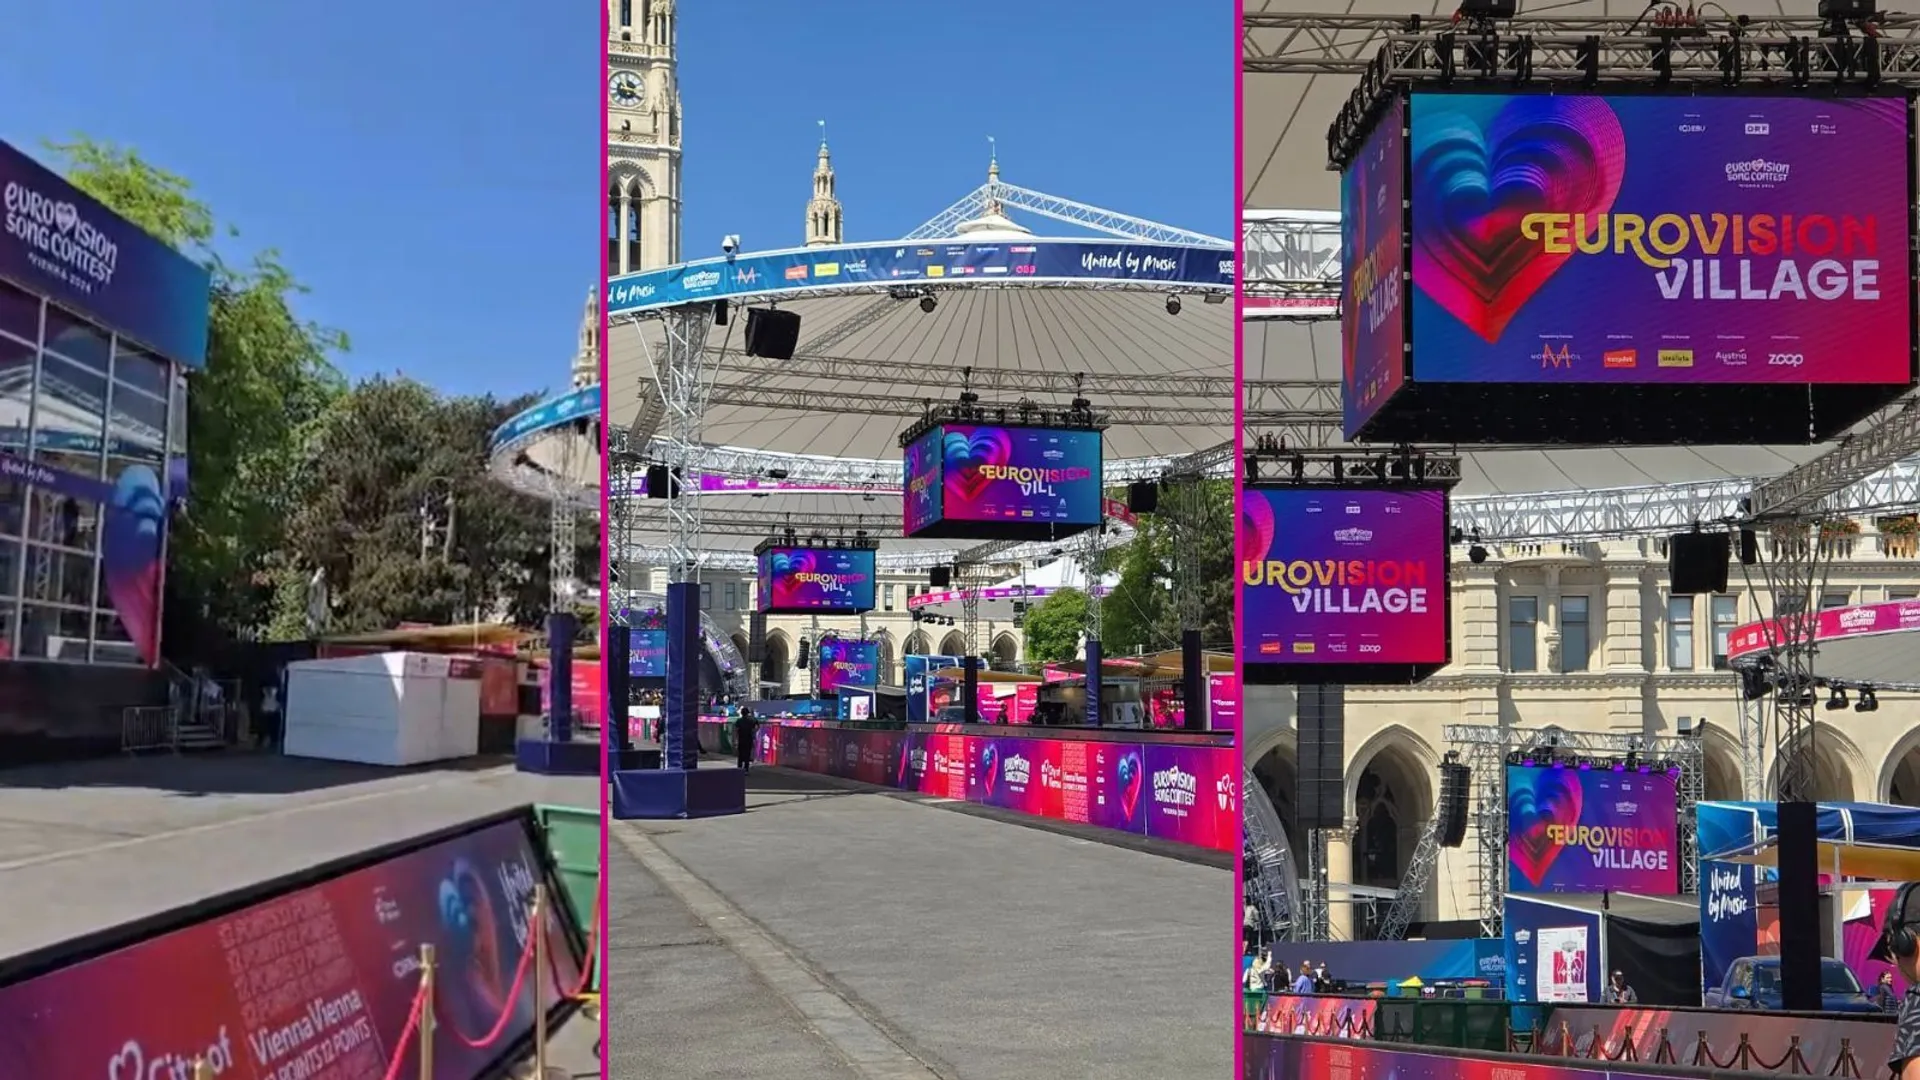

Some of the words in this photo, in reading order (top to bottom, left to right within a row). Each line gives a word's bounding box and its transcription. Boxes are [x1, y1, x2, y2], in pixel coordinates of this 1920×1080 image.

[1747, 125, 1767, 133] ORF
[1727, 172, 1750, 181] SONG
[1750, 172, 1788, 182] CONTEST
[4, 211, 51, 253] SONG
[50, 232, 114, 285] CONTEST
[1521, 213, 1877, 268] EUROVISION
[1081, 252, 1120, 271] United
[1125, 253, 1140, 273] by
[1143, 255, 1177, 272] Music
[1654, 257, 1880, 300] VILLAGE
[616, 285, 628, 305] by
[1715, 348, 1747, 361] Austria
[979, 464, 1091, 485] EUROVISION
[1292, 587, 1428, 613] VILLAGE
[1547, 824, 1669, 853] EUROVISION
[1593, 848, 1669, 870] VILLAGE
[1711, 864, 1742, 892] United
[1708, 893, 1720, 922] by
[1719, 896, 1748, 920] Music
[206, 1024, 233, 1075] of
